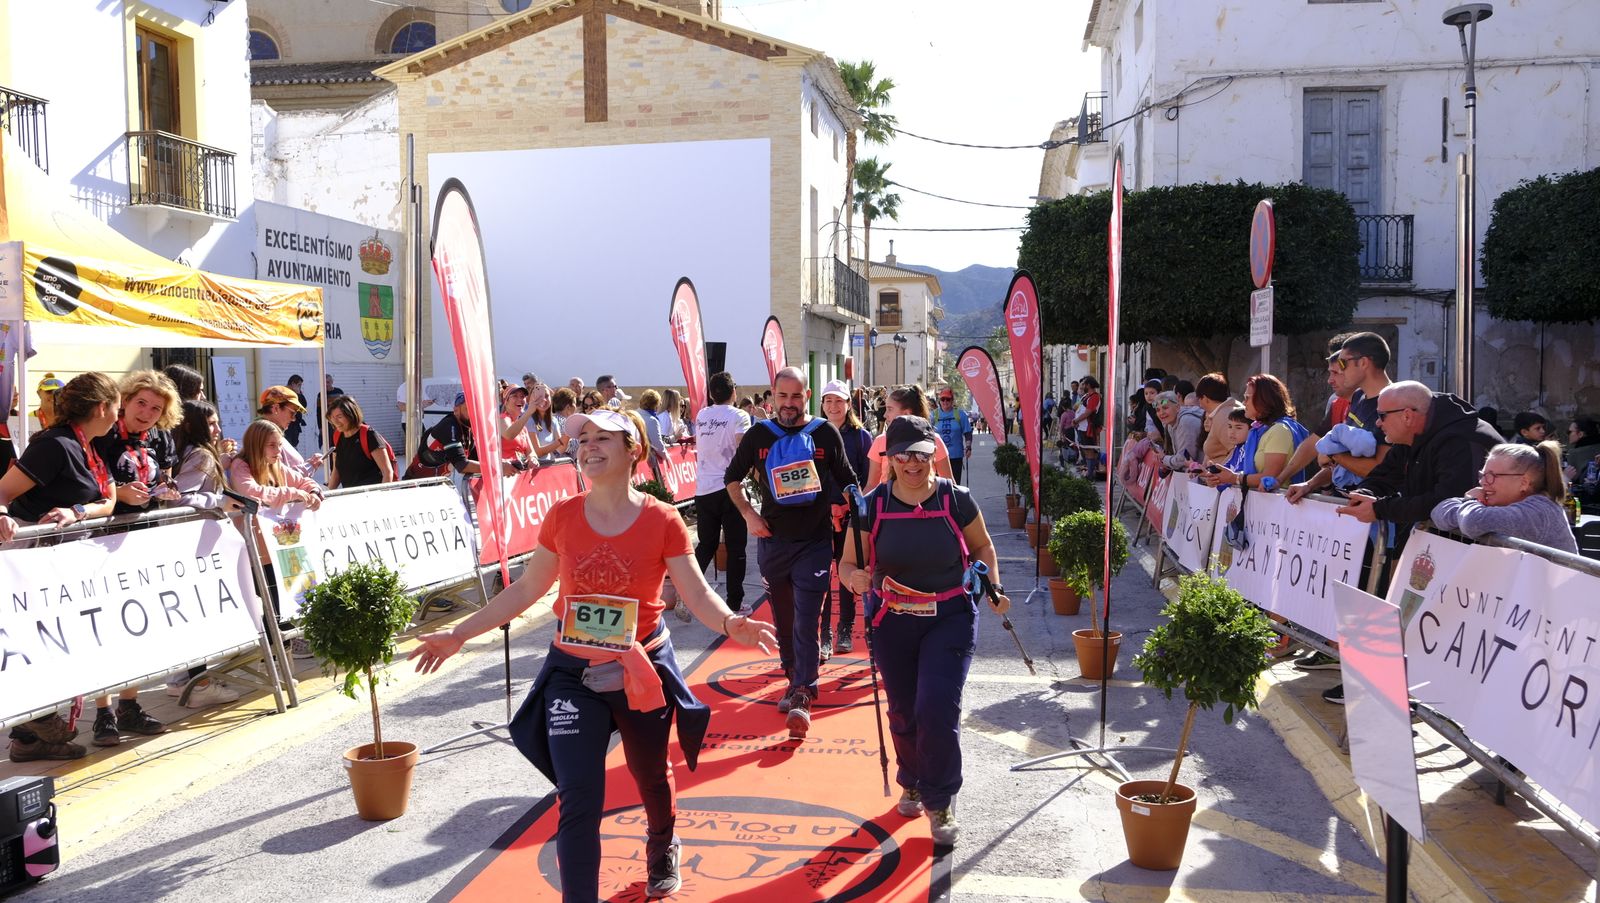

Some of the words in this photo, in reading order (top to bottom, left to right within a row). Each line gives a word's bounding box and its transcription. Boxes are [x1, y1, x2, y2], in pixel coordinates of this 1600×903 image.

[265, 228, 353, 261] EXCELENTÍSIMO
[43, 274, 57, 282] uno
[267, 259, 351, 287] AYUNTAMIENTO
[325, 322, 342, 339] RIA
[674, 461, 697, 484] VEOL
[781, 468, 810, 483] 582
[320, 511, 435, 542] AYUNTAMIENTO
[440, 508, 457, 521] DE
[323, 525, 466, 578] CANTORIA
[1332, 539, 1352, 560] DE
[12, 560, 186, 613] NTAMIENTO
[196, 553, 223, 573] DE
[0, 578, 239, 671] ANTORIA
[576, 605, 622, 626] 617
[1419, 611, 1600, 750] CANTOR
[700, 741, 881, 757] Ayuntamient
[707, 733, 824, 744] Cntoria
[832, 737, 866, 745] de
[735, 833, 781, 843] Cxm
[811, 824, 859, 838] LA
